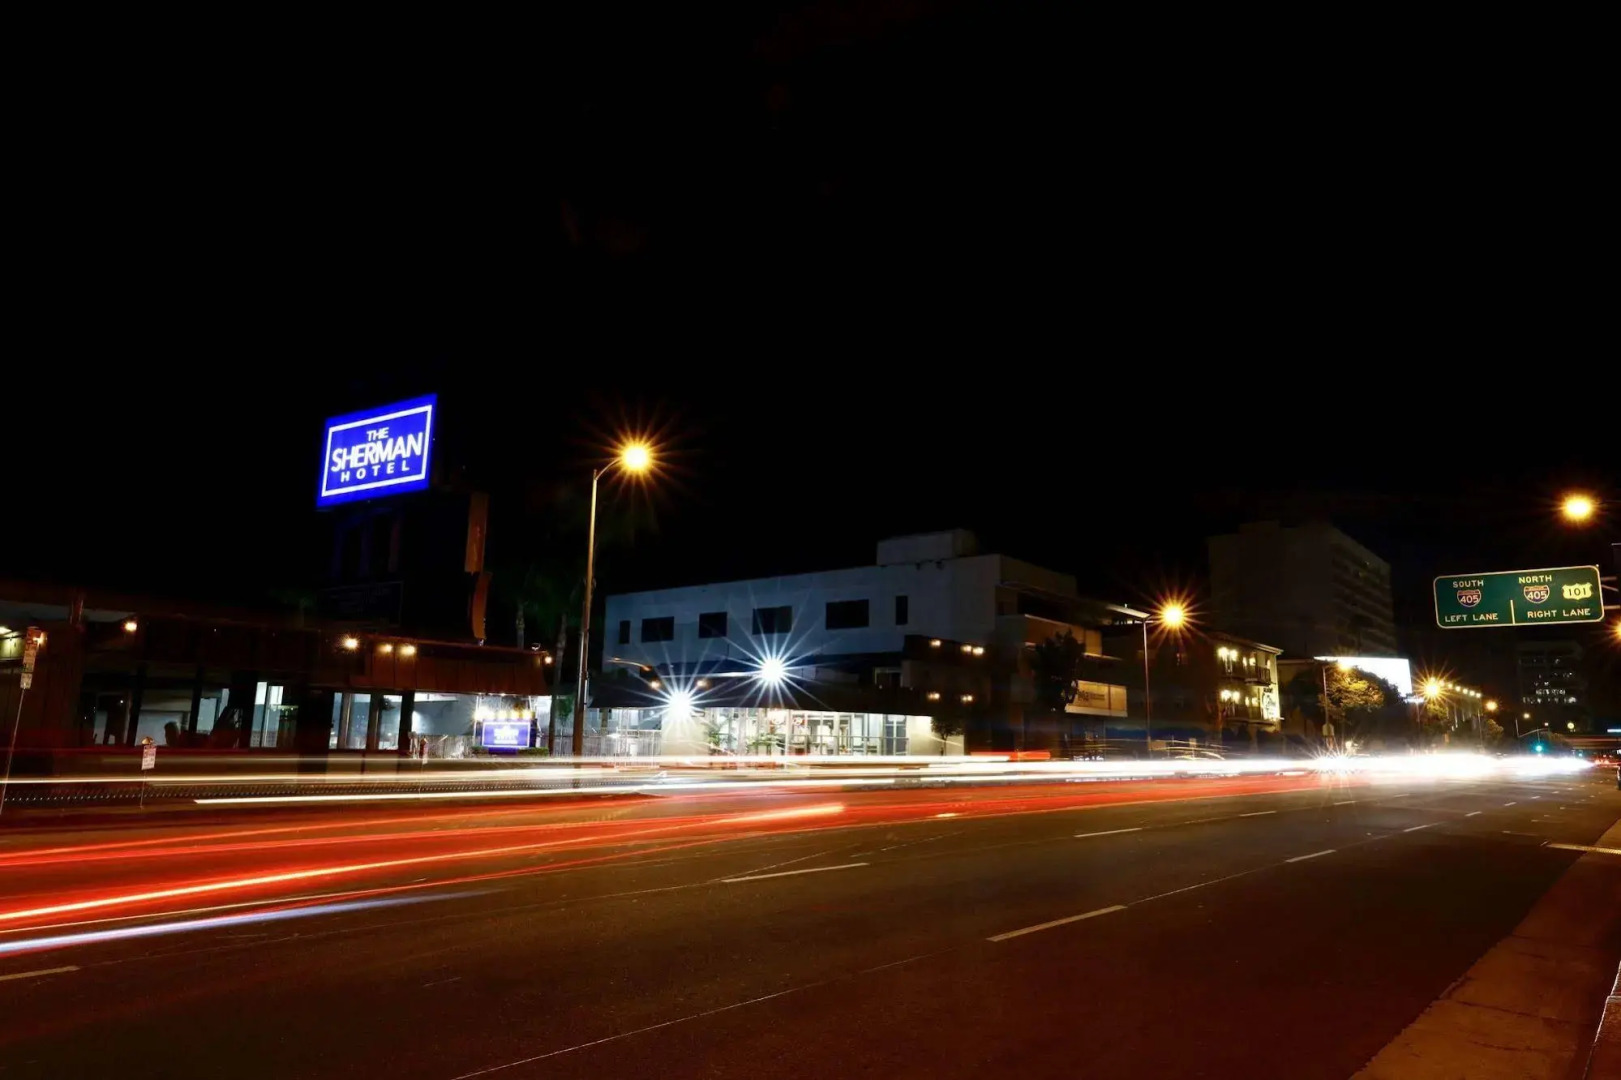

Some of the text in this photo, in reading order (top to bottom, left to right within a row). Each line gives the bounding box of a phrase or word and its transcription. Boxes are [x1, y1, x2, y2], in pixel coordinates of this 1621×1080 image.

[366, 427, 389, 441] THE
[330, 432, 423, 472] SHERMAN
[340, 460, 410, 483] HOTEL
[1452, 579, 1484, 588] SOUTH
[1518, 574, 1552, 584] NORTH
[1527, 590, 1547, 601] 405
[1568, 587, 1587, 596] 101
[1460, 595, 1479, 604] 405
[1445, 612, 1499, 623] LEFT LANE
[1527, 608, 1591, 619] RIGHT LANE
